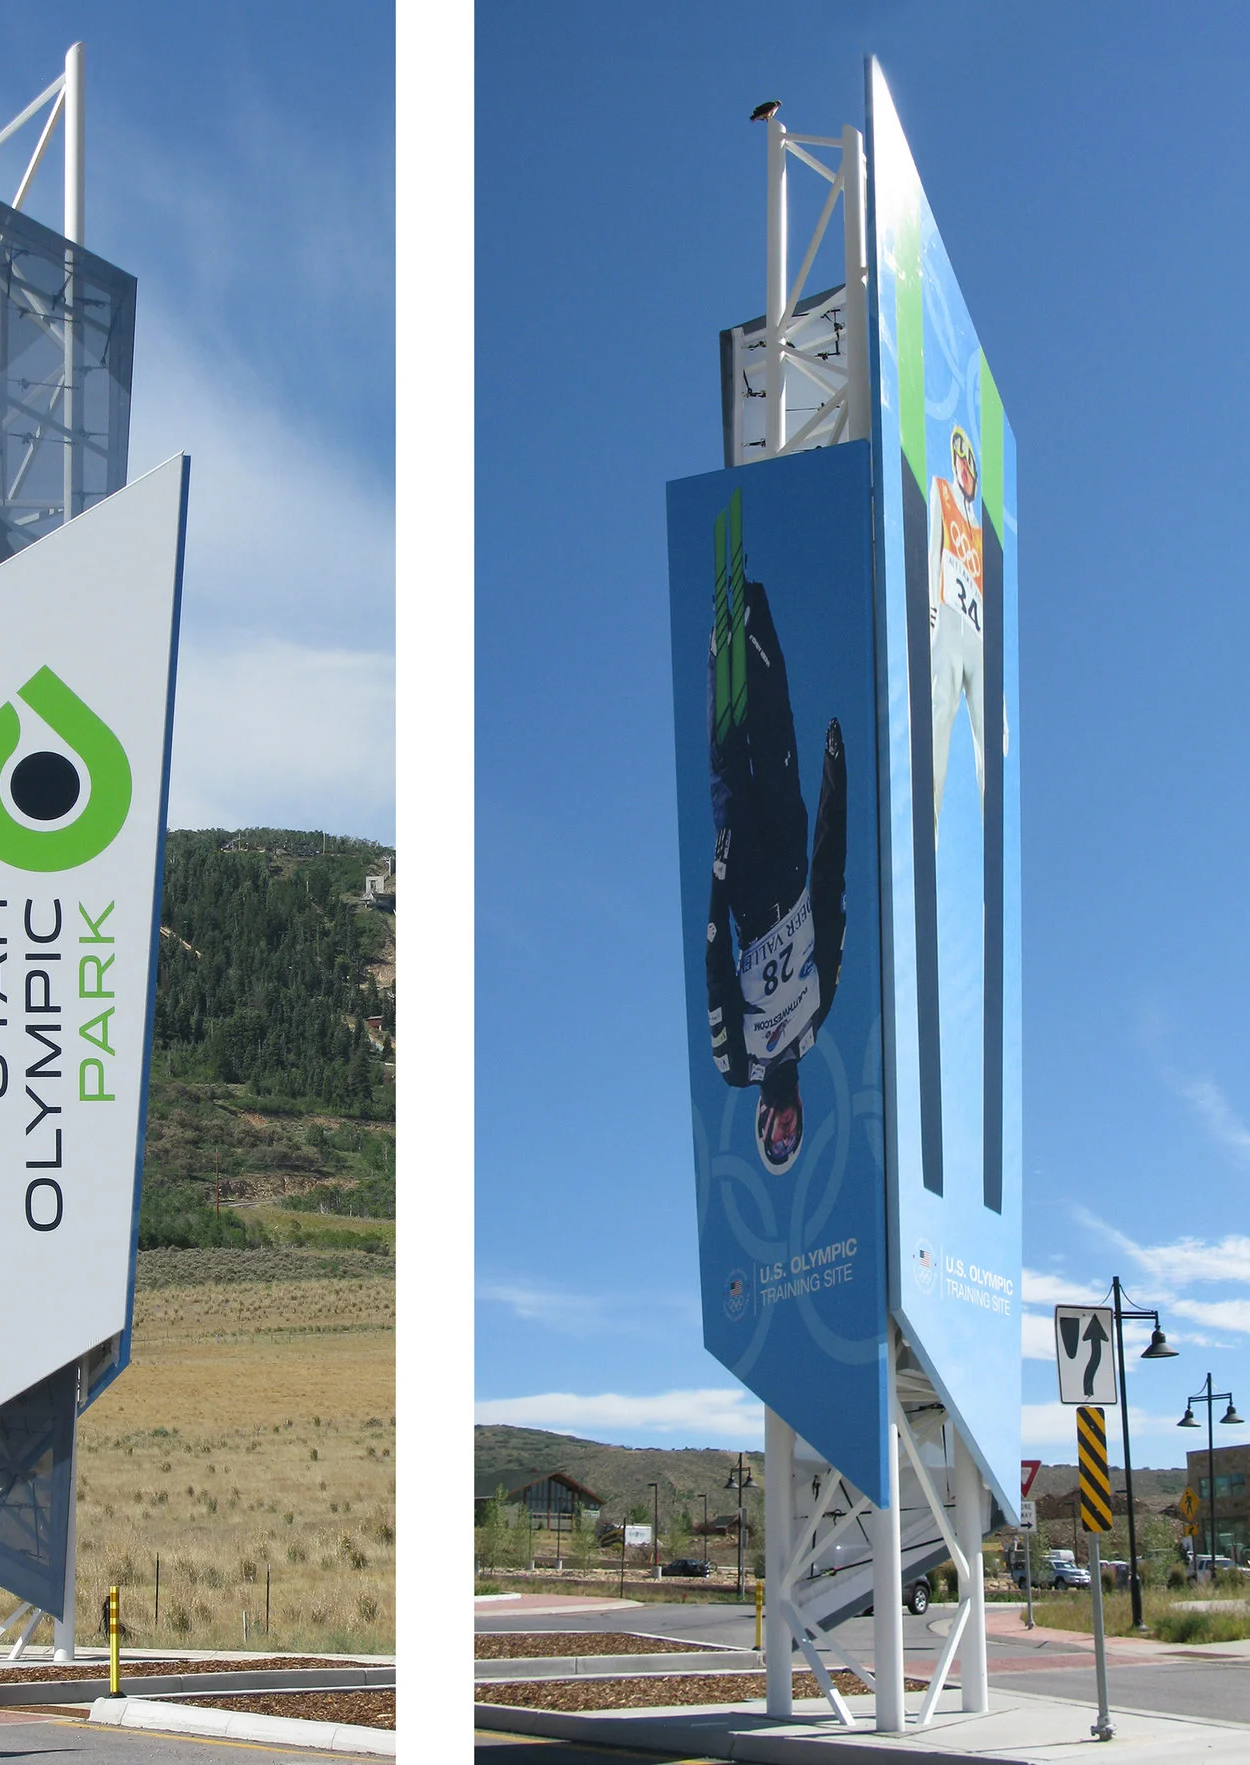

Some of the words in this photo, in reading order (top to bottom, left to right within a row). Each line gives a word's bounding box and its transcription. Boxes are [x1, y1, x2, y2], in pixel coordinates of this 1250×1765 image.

[763, 942, 793, 996] 28
[79, 900, 115, 1101] PARK
[24, 898, 63, 1232] OLYMPIC
[760, 1262, 786, 1284] U.S.
[791, 1238, 857, 1274] OLYMPIC
[945, 1255, 966, 1278] U.S.
[969, 1264, 1013, 1296] OLYMPIC
[760, 1273, 820, 1307] TRAINING
[824, 1263, 852, 1288] SITE
[946, 1277, 990, 1309] TRAINING
[992, 1294, 1011, 1317] SITE
